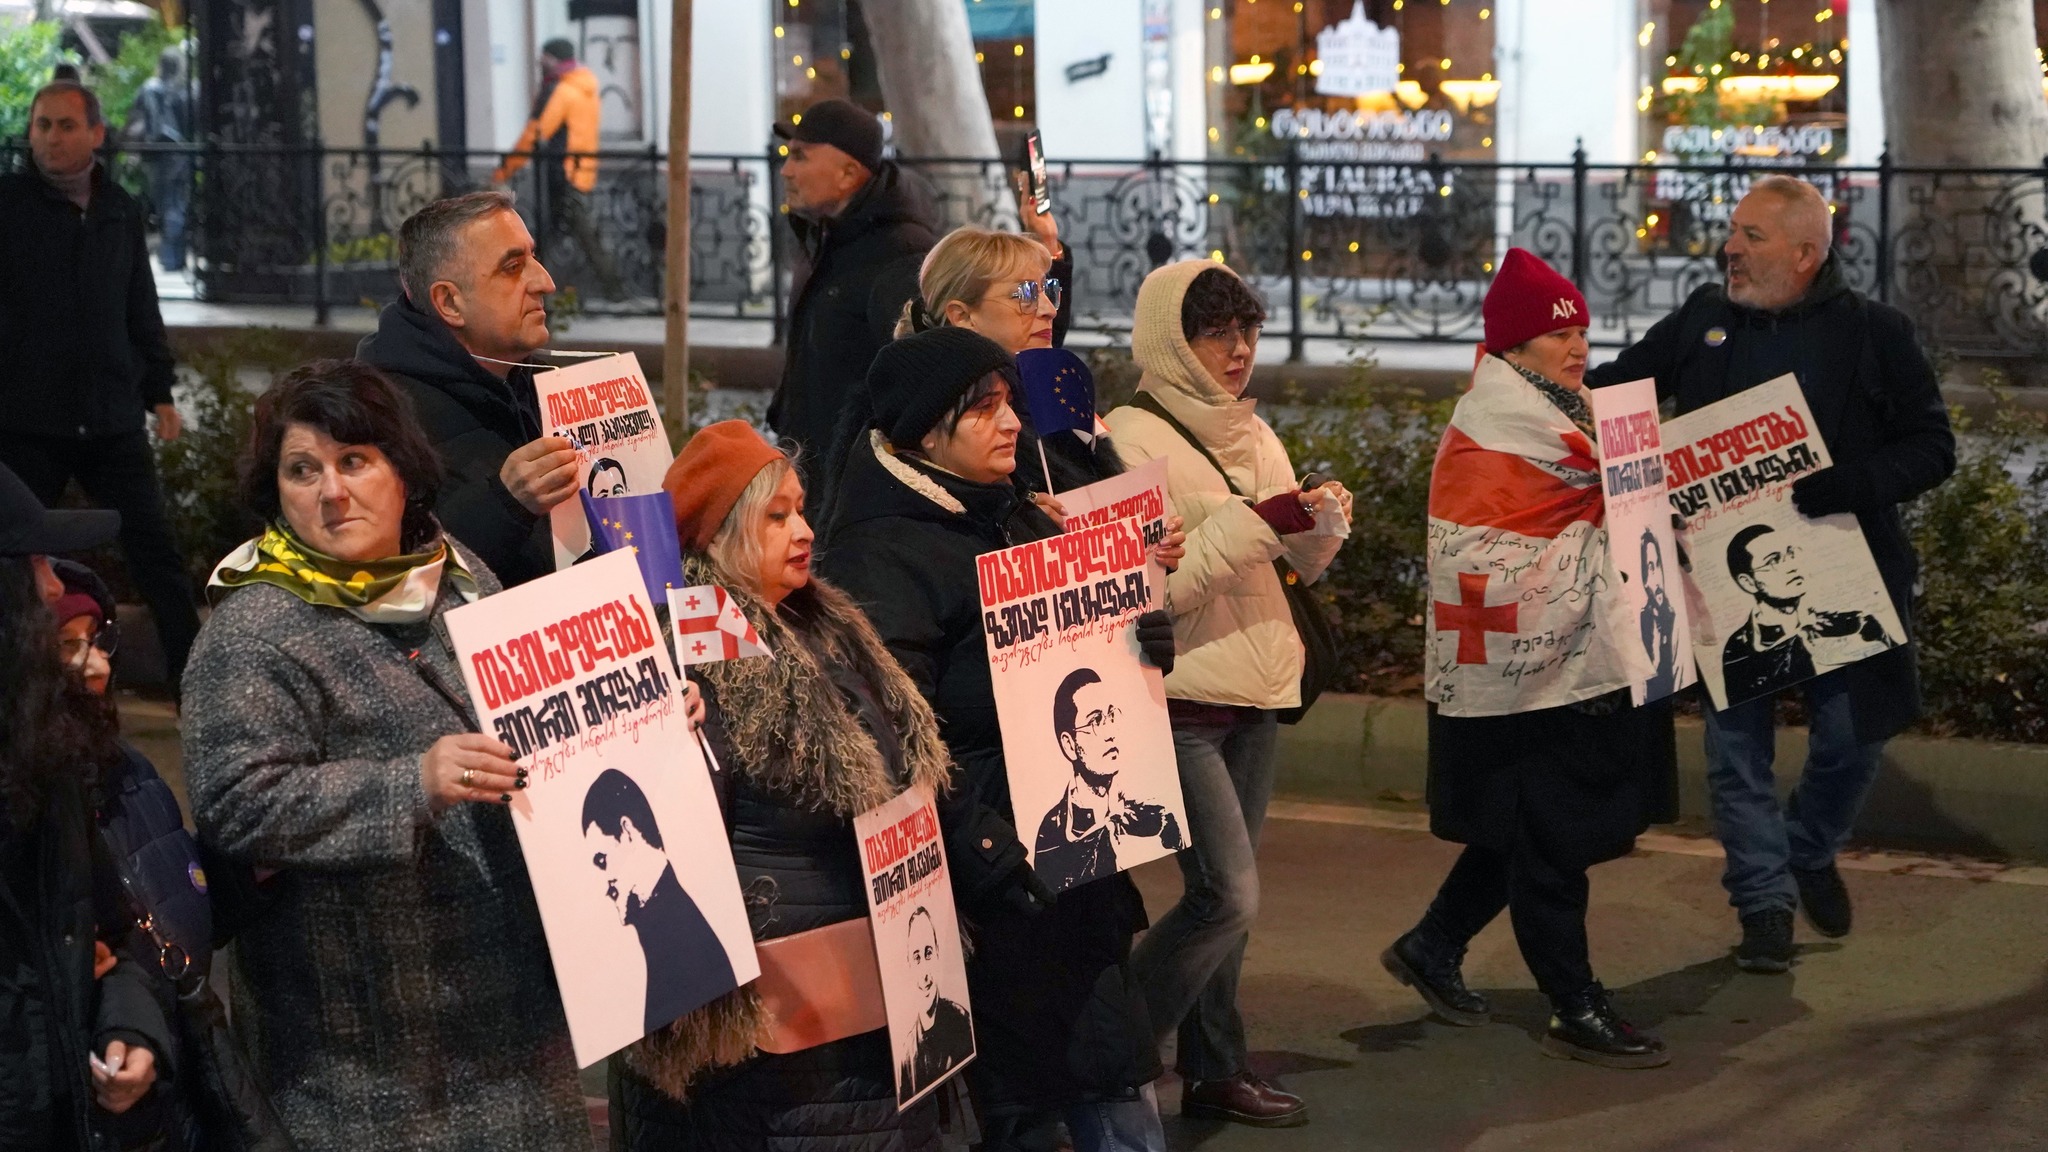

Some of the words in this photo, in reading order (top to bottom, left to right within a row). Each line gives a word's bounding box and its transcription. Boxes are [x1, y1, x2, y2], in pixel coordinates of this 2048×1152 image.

[547, 375, 648, 428] თავისუფლება
[1664, 405, 1809, 490] ვისუფლება
[1669, 483, 1711, 518] იად
[978, 517, 1146, 607] თავისუფლება
[985, 597, 1049, 650] ზვიად
[1052, 570, 1151, 633] ცეცხლაძეს
[471, 594, 655, 711] თავისუფლება
[493, 691, 580, 760] გიორგი
[576, 655, 672, 727] მინდაძეს
[865, 802, 937, 875] თავისუფლება
[872, 862, 907, 906] გიორგი
